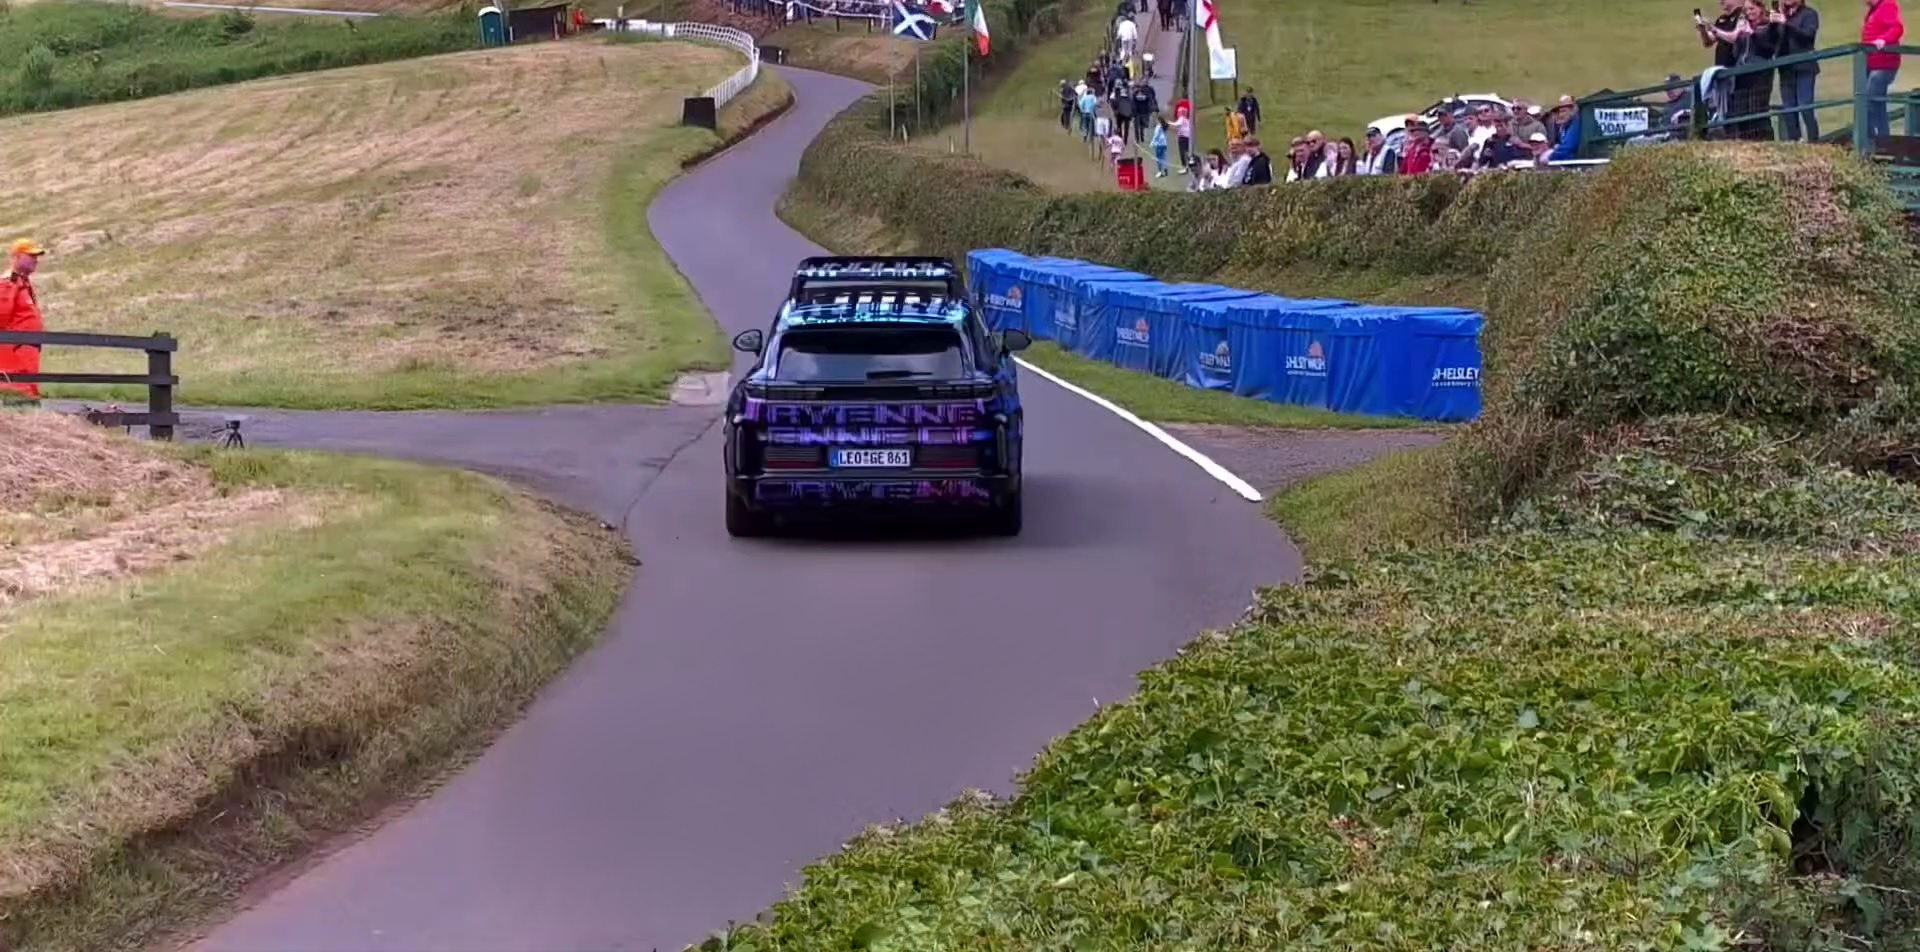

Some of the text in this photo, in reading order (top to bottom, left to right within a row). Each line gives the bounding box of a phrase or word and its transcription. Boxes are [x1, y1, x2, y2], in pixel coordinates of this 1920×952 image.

[839, 451, 908, 465] LEO GE 861
